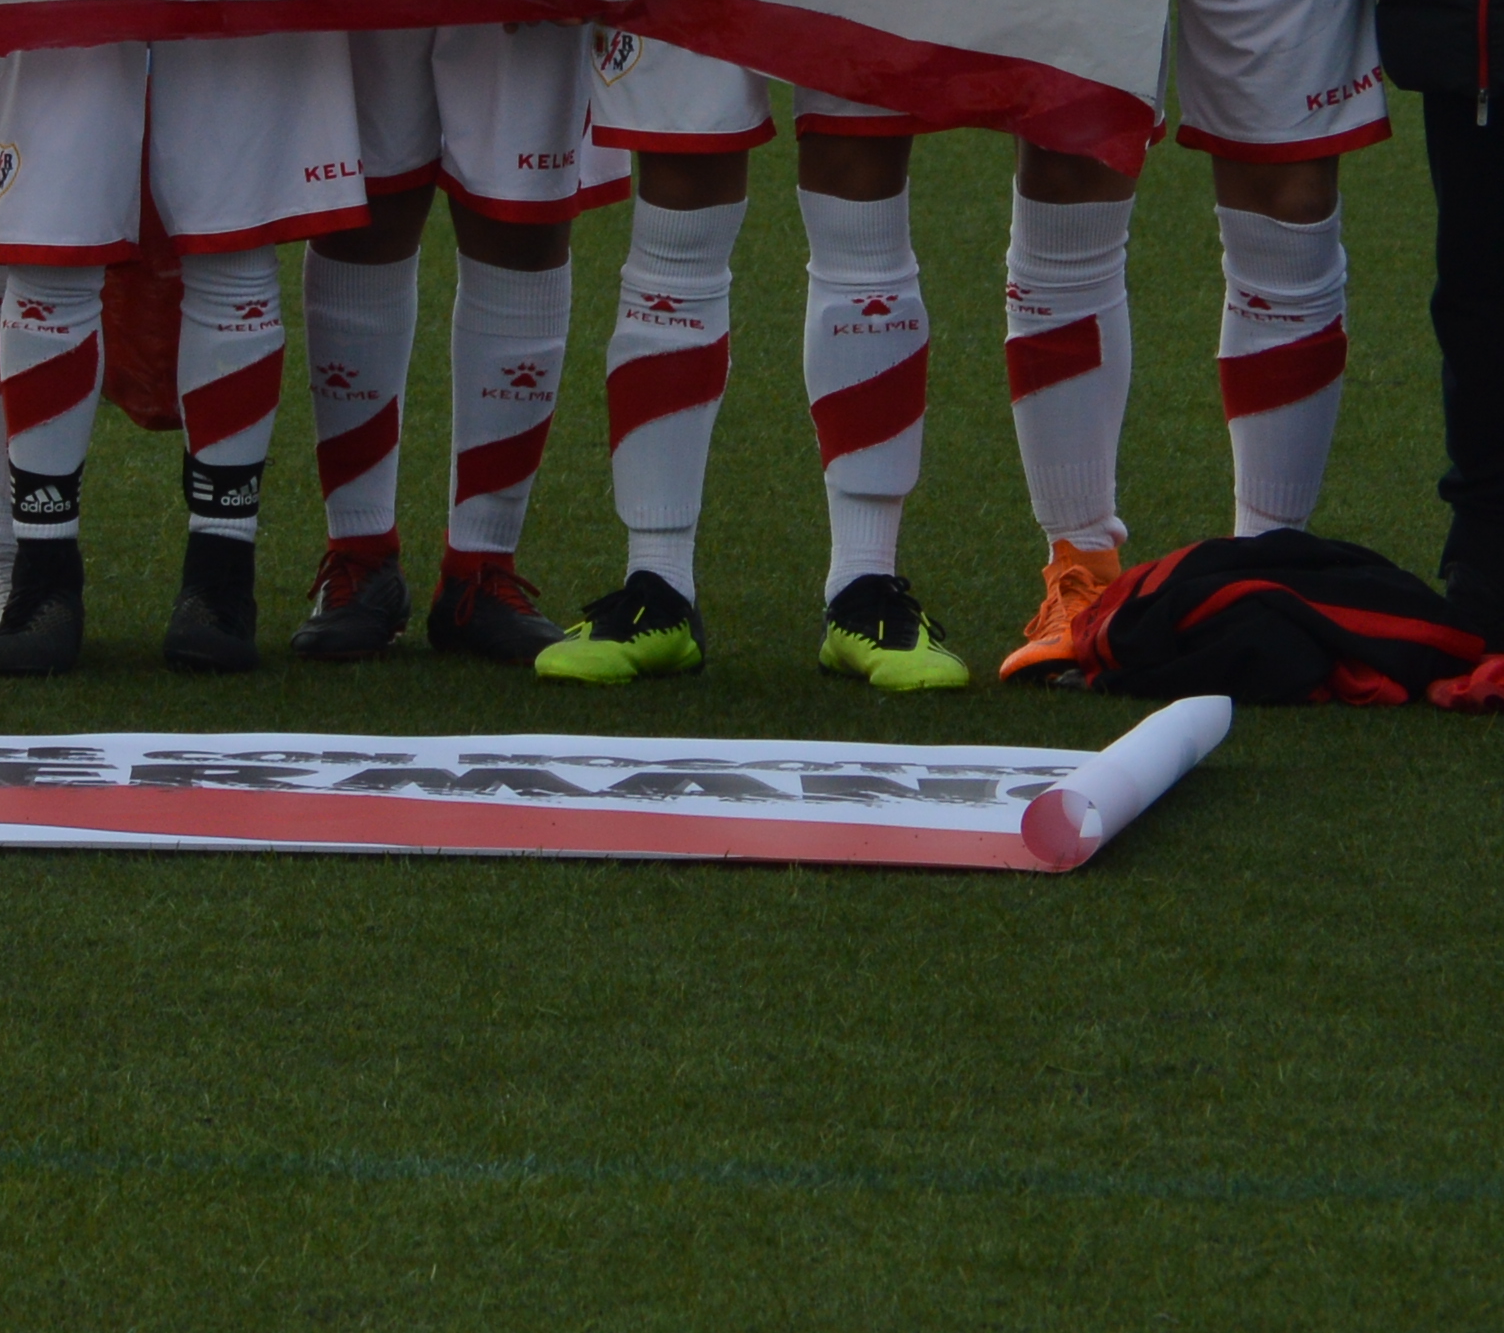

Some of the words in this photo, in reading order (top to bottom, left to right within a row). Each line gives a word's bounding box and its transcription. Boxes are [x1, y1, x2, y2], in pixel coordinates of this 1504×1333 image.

[1305, 65, 1384, 111] KELME
[517, 150, 575, 170] KELME
[2, 320, 70, 335] KELME
[217, 318, 282, 333] KELME
[625, 308, 705, 331] KELME
[832, 318, 920, 338] KELME
[482, 387, 554, 403] KELME
[20, 500, 72, 515] adidas
[142, 750, 418, 766] CON
